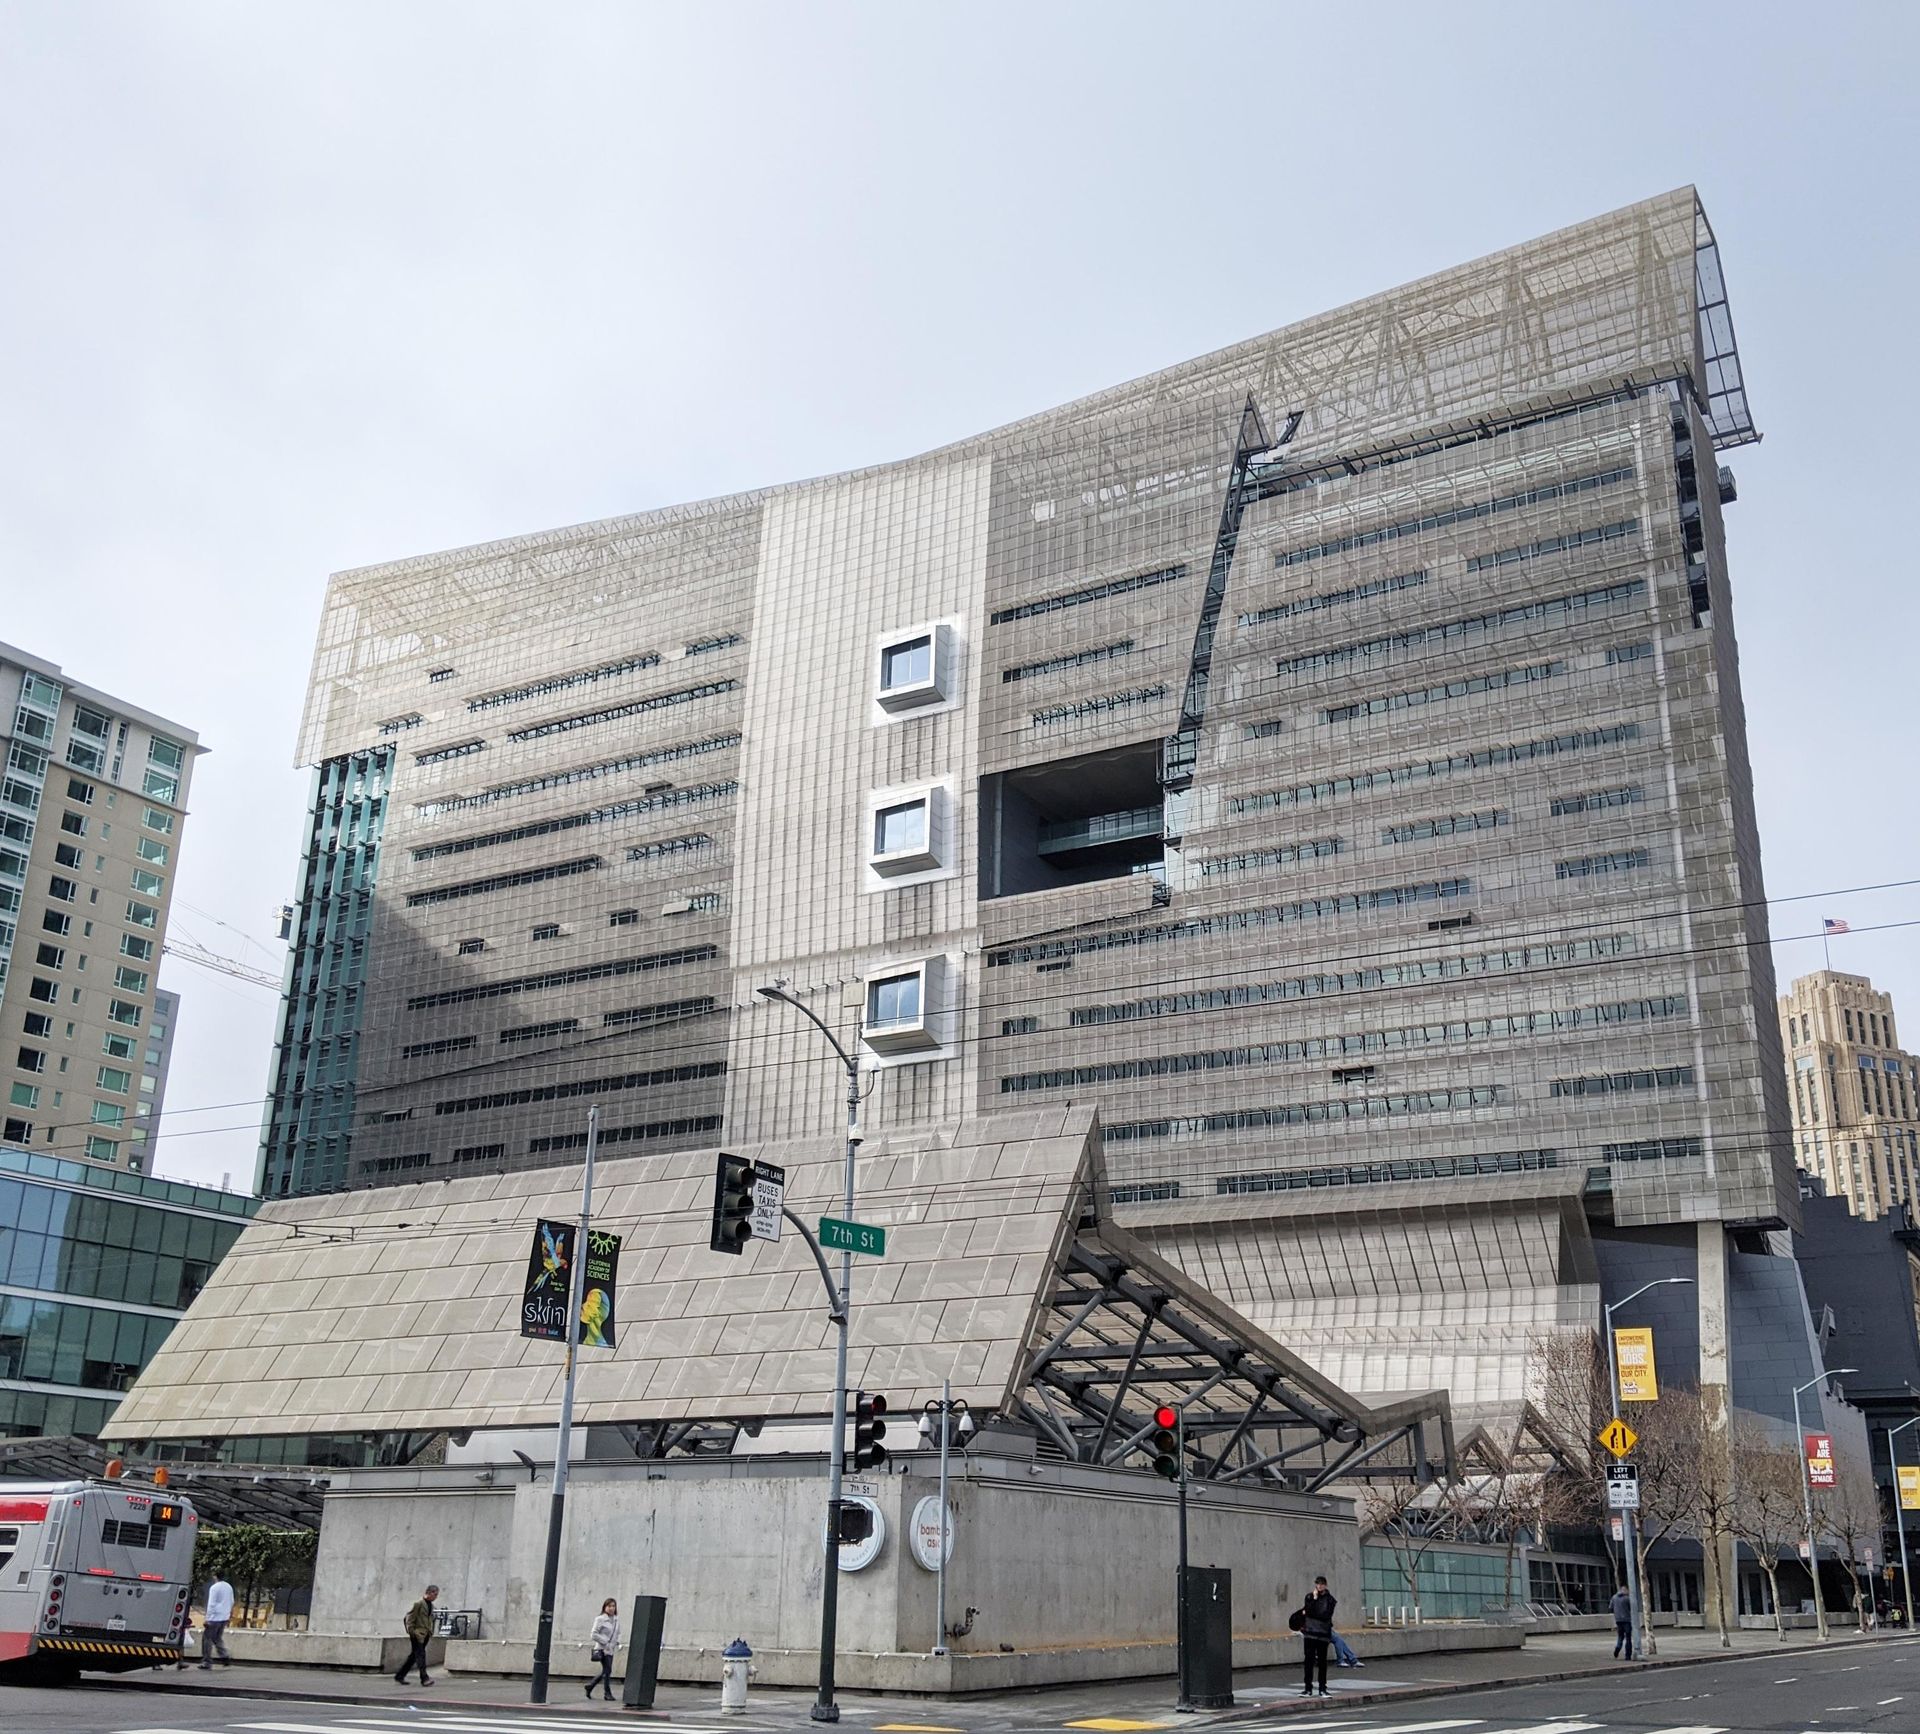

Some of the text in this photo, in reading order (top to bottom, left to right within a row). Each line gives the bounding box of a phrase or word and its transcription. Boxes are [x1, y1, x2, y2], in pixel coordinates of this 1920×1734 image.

[755, 1165, 783, 1181] RIGHT LANE
[757, 1182, 779, 1197] BUSES
[758, 1195, 776, 1208] TAXIS
[757, 1207, 775, 1219] ONLY
[831, 1225, 874, 1248] 7th St
[587, 1264, 605, 1273] ACADEMY
[588, 1258, 611, 1268] CALIFORNIA
[586, 1270, 610, 1281] SCIENCES
[524, 1296, 566, 1326] skin
[1817, 1439, 1830, 1449] WE
[1816, 1449, 1831, 1458] ARE
[129, 1502, 147, 1511] 7228
[161, 1506, 172, 1519] 14
